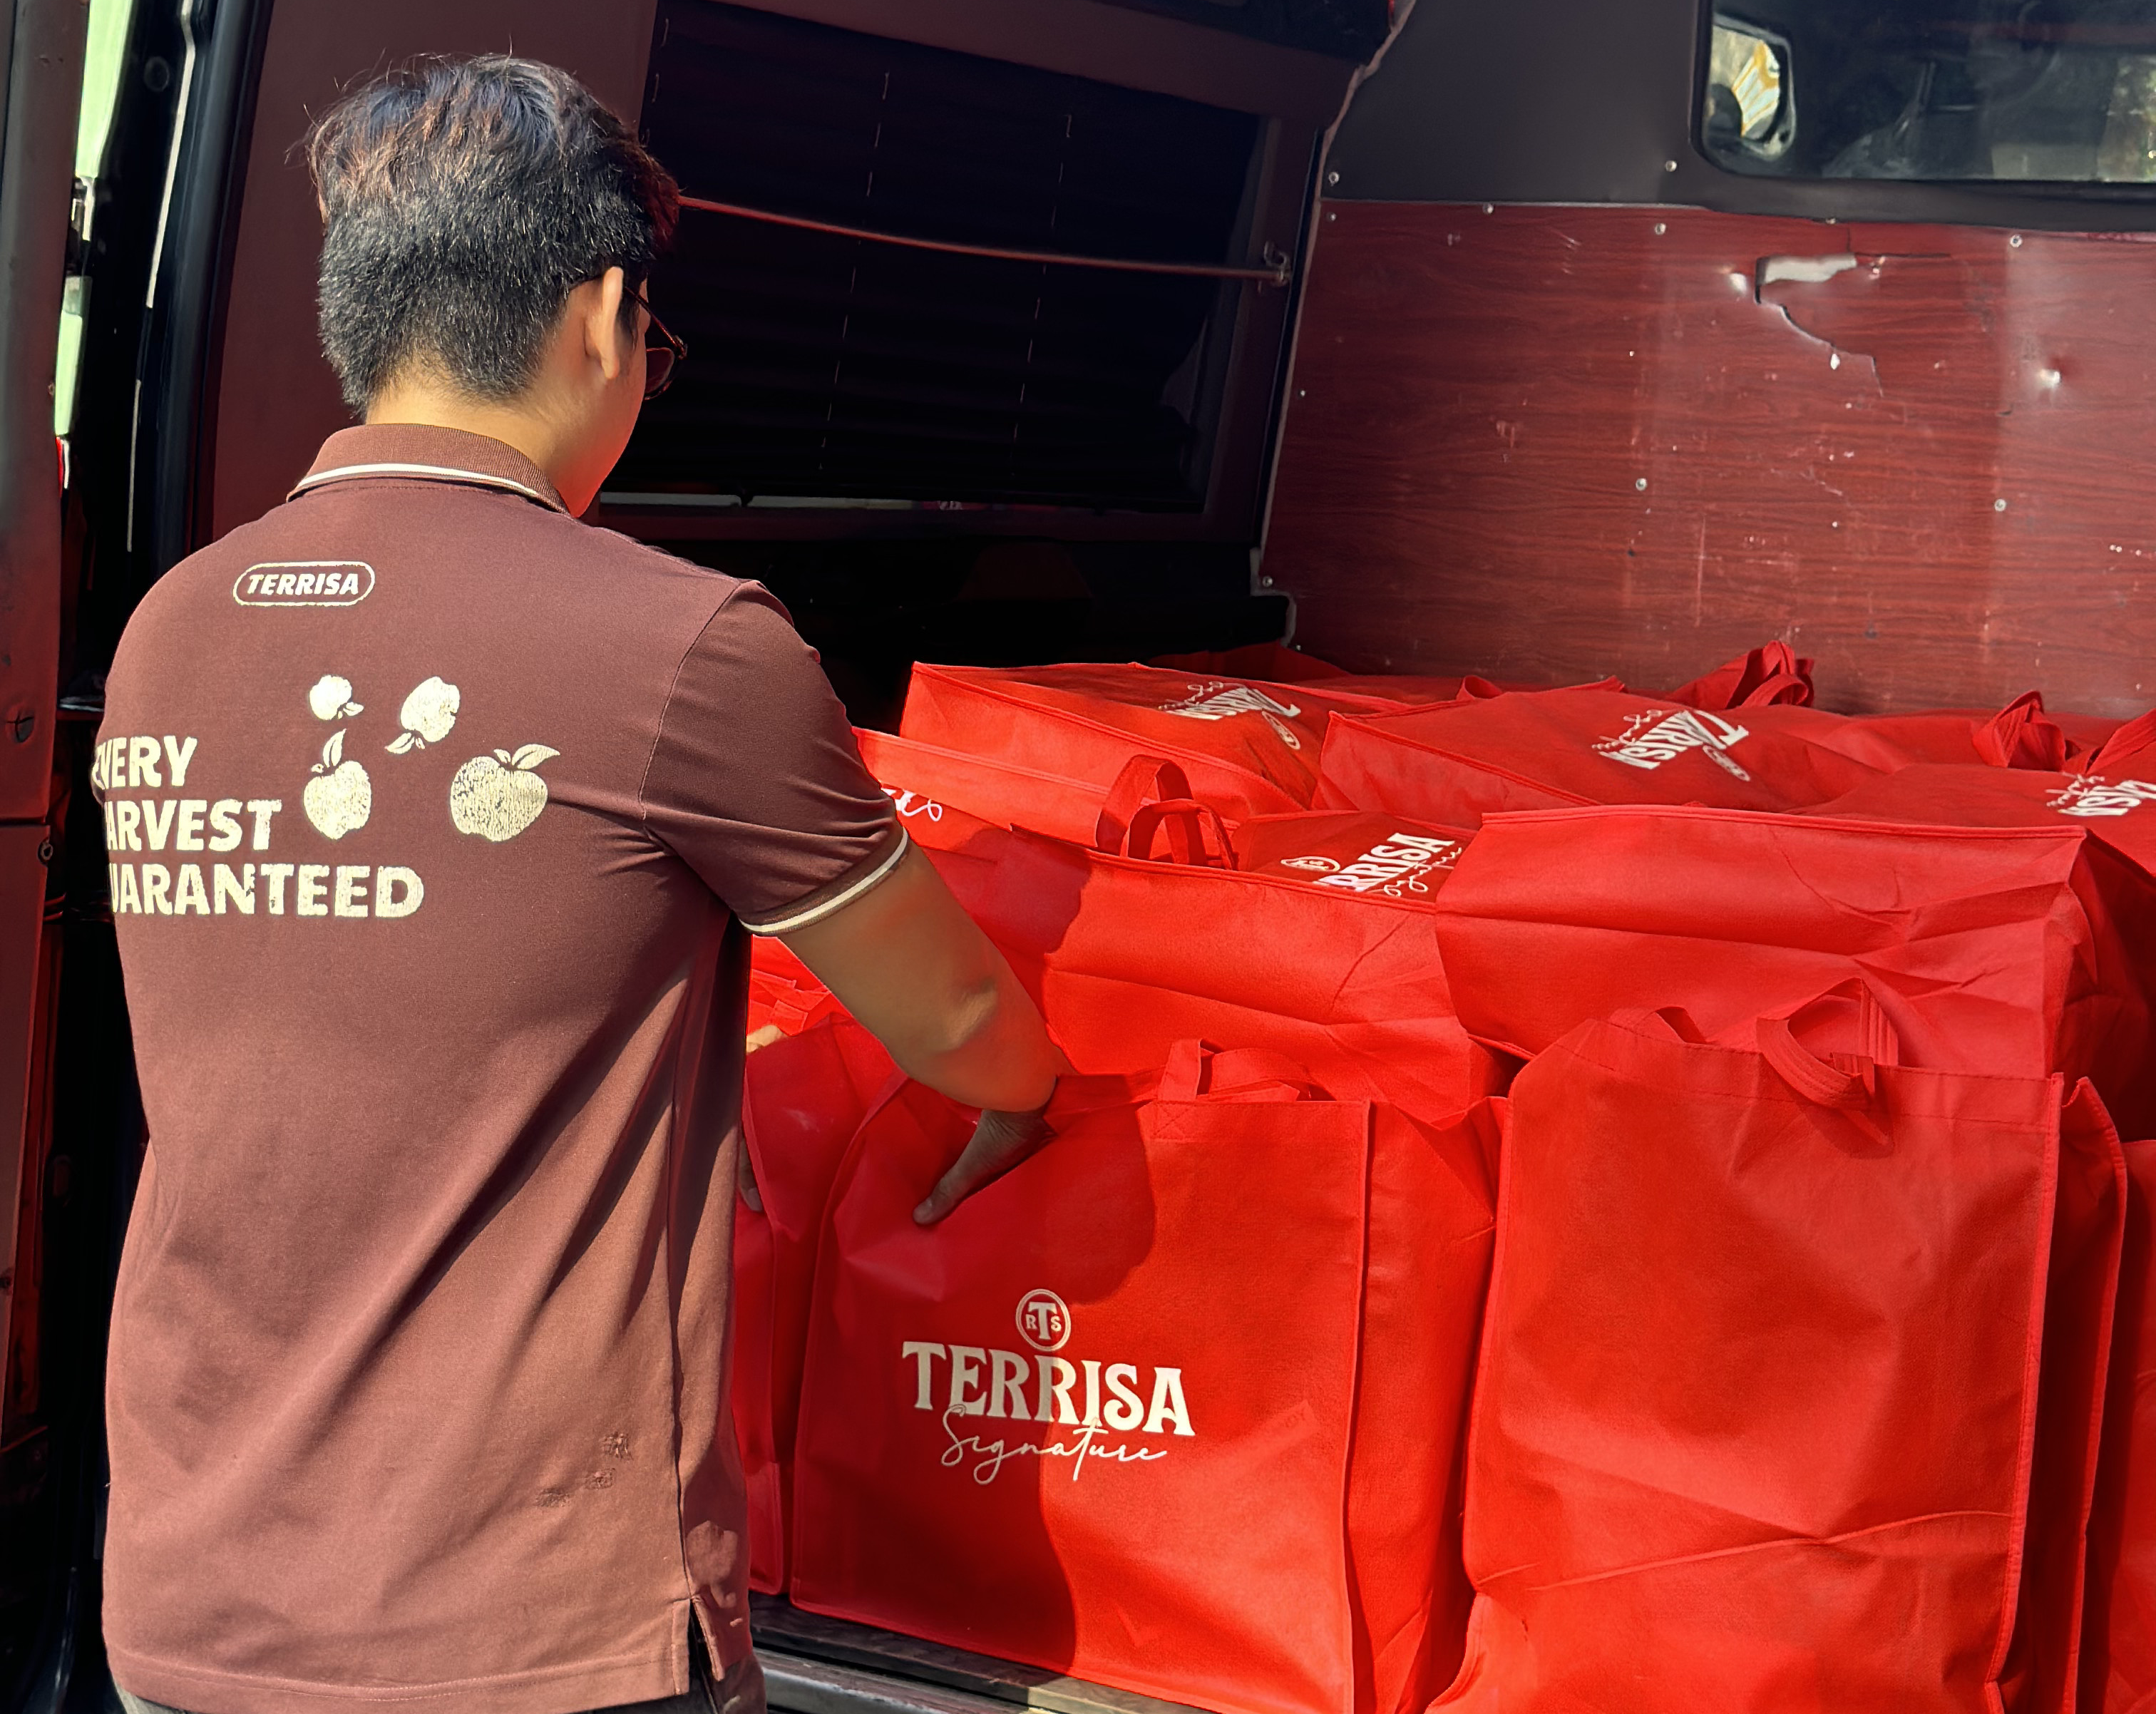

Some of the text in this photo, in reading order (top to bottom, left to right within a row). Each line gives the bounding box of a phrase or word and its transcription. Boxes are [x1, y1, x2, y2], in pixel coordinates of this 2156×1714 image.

[247, 573, 359, 595] TERRISA
[105, 799, 282, 852] ARVEST
[109, 863, 424, 918] UARANTEED
[903, 1341, 1196, 1436] TERRISA
[941, 1403, 1168, 1485] Signature
